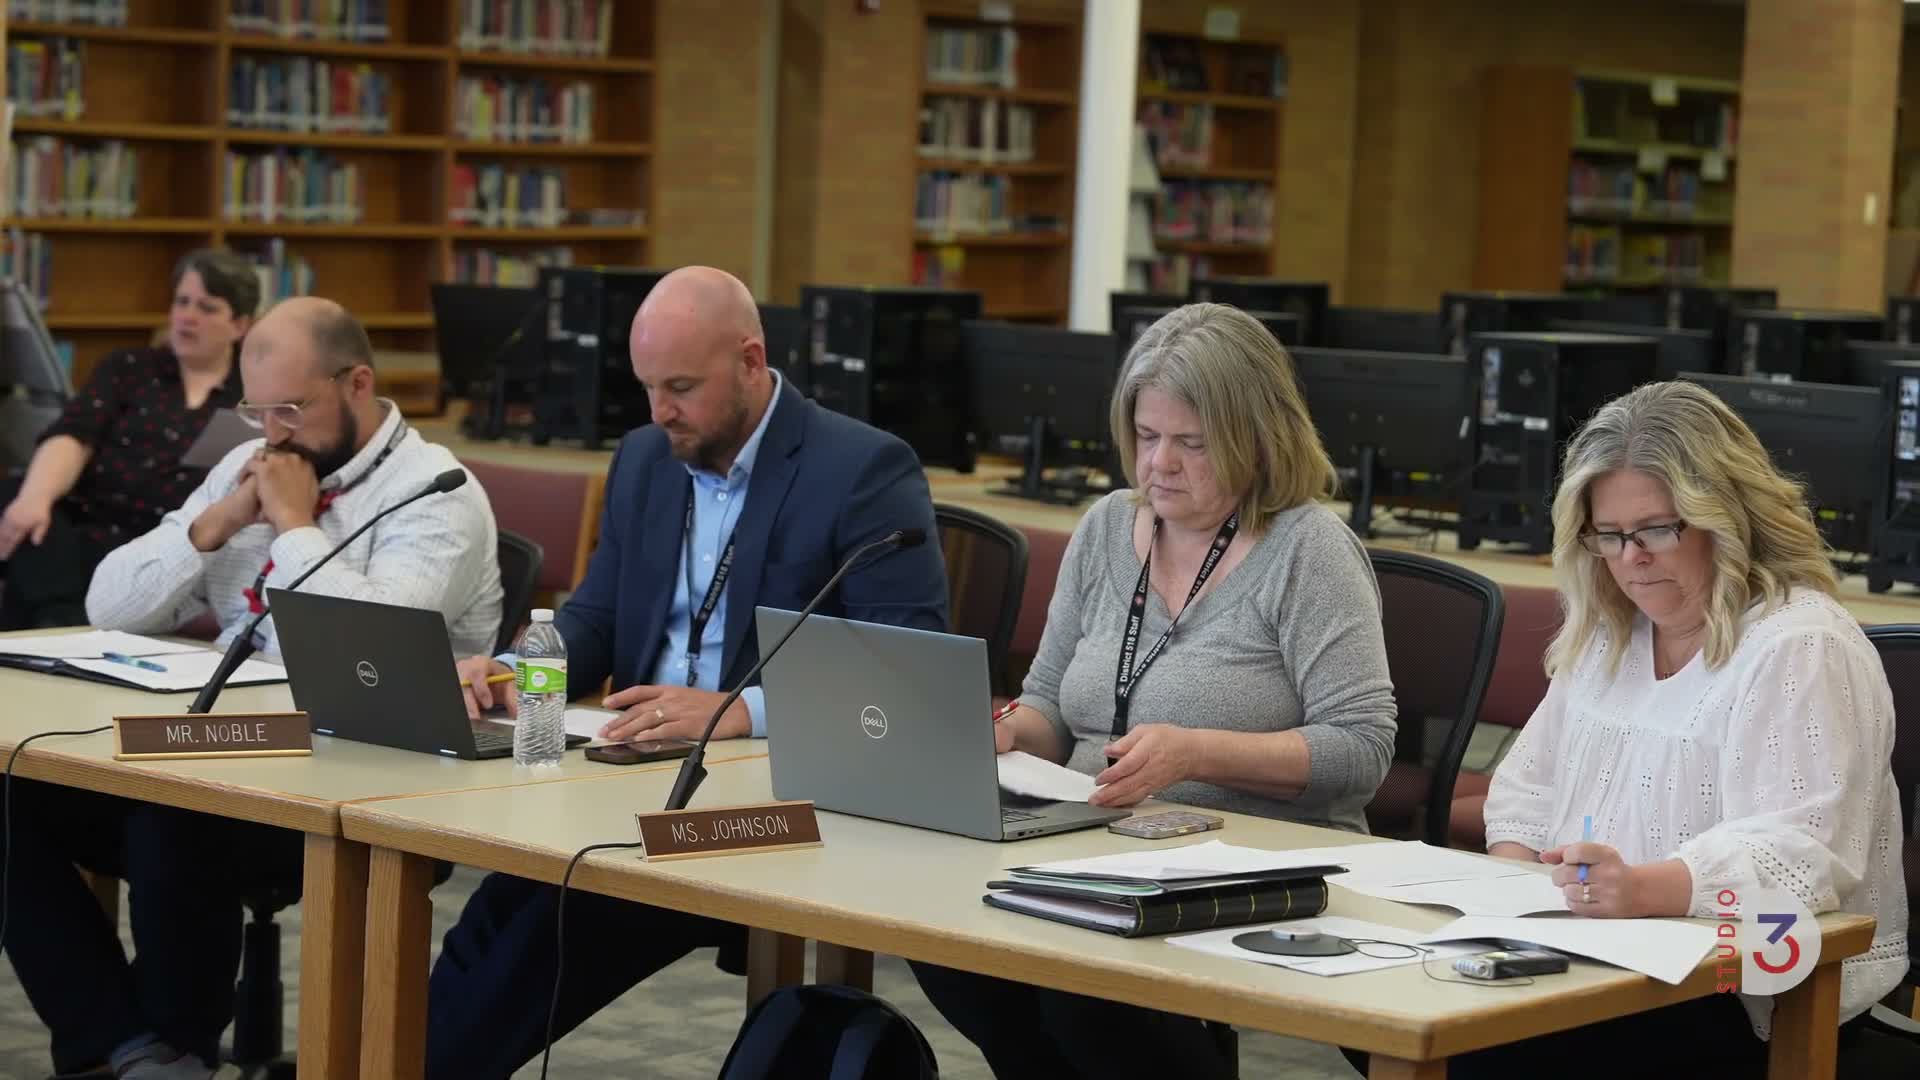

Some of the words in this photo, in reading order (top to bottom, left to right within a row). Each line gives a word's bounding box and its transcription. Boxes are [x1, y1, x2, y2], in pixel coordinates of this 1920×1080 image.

[1199, 548, 1220, 580] District
[1128, 615, 1140, 636] Staff
[1125, 635, 1136, 651] 518
[1145, 635, 1168, 663] District
[1119, 651, 1134, 683] District
[165, 724, 200, 744] MR.
[205, 723, 269, 743] NOBLE
[864, 716, 885, 728] DELL
[671, 822, 705, 844] MS.
[711, 815, 790, 842] JOHNSON
